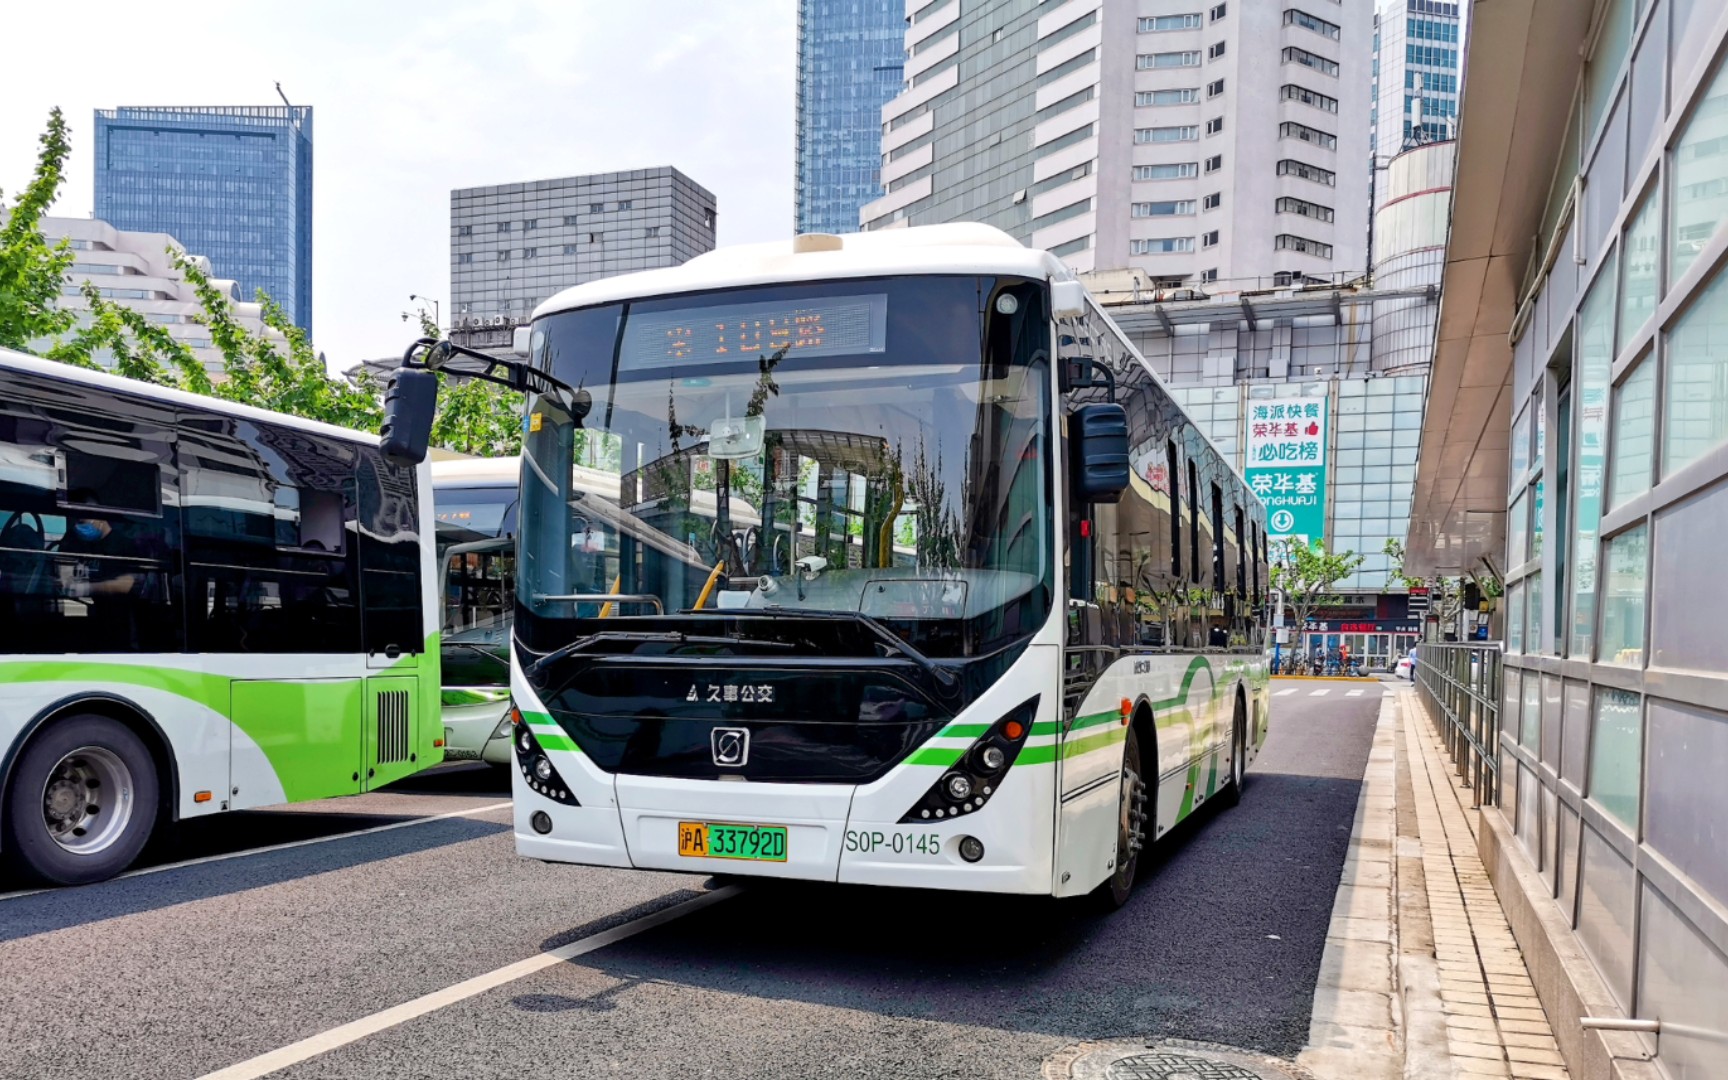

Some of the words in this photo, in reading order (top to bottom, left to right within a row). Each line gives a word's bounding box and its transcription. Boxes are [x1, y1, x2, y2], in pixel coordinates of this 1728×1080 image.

[1253, 403, 1319, 420] 海派快餐
[1252, 422, 1298, 437] 荣华基
[1258, 441, 1319, 461] 必吃榜
[1251, 472, 1317, 494] 荣华基
[706, 684, 773, 703] 久事公交
[713, 829, 784, 857] 33792D
